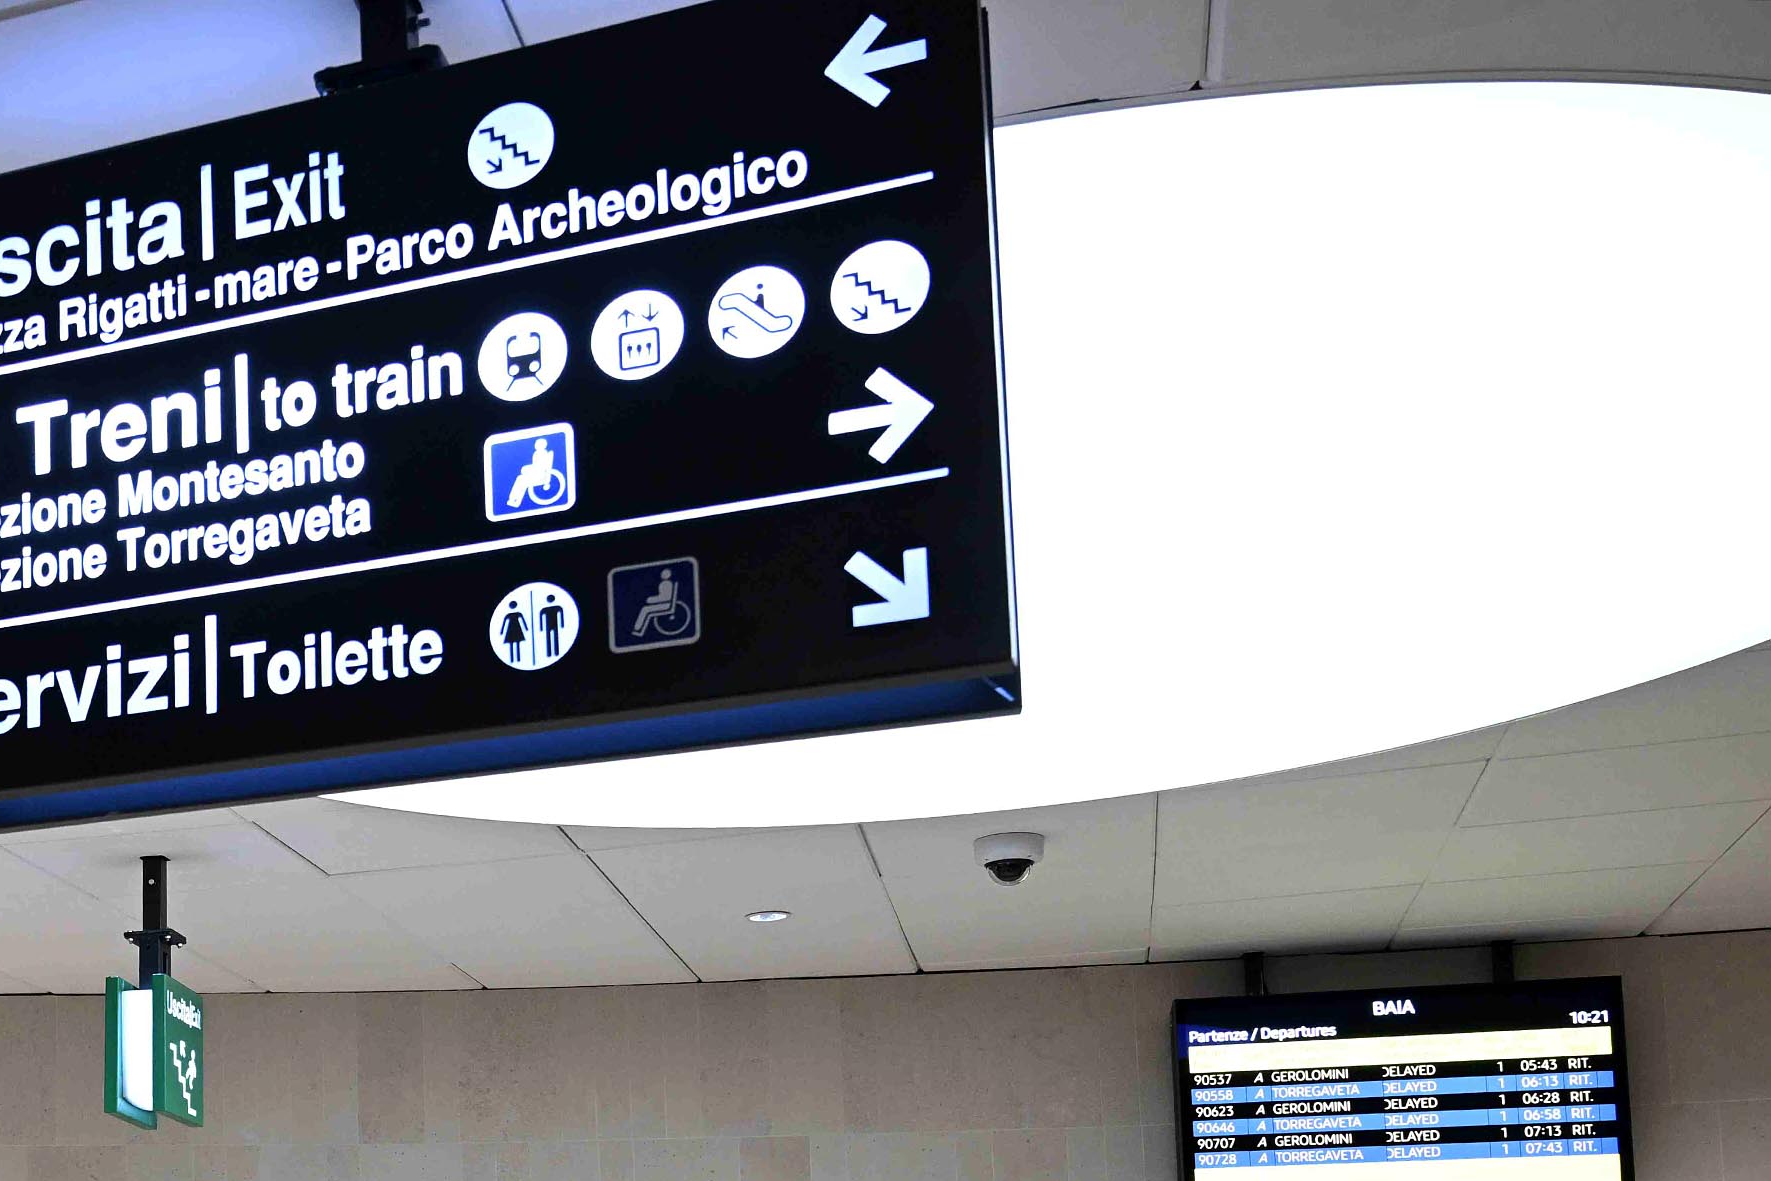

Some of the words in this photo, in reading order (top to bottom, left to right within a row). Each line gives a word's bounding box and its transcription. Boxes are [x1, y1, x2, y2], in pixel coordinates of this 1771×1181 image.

[234, 152, 346, 240] Exit
[59, 273, 187, 343] Rigatti
[488, 150, 808, 251] Archeologico
[16, 367, 222, 476] Treni
[261, 376, 317, 431] to
[332, 345, 464, 419] train
[117, 439, 366, 517] Montesanto
[117, 495, 372, 571] Torregaveta
[230, 624, 444, 698] Toilette
[1372, 999, 1416, 1017] BAIA
[1569, 1010, 1609, 1024] 10:21
[1189, 1029, 1248, 1044] Partenze
[1250, 1027, 1259, 1041] /
[1260, 1026, 1337, 1042] Departures
[1194, 1074, 1232, 1086] 90537
[1254, 1073, 1264, 1083] A
[1271, 1068, 1349, 1083] GEROLOMINI
[1497, 1061, 1504, 1072] 1
[1520, 1059, 1558, 1071] 05:43
[1568, 1057, 1592, 1069] RIT.
[1195, 1090, 1233, 1101] 90558
[1255, 1089, 1265, 1099] A
[1272, 1084, 1360, 1098] TORREGAVETA
[1498, 1078, 1505, 1088] 1
[1521, 1075, 1559, 1087] 06:13
[1569, 1074, 1593, 1086] RIT.
[1196, 1105, 1234, 1118] 90623
[1256, 1105, 1266, 1115] A
[1273, 1101, 1351, 1114] GEROLOMINI
[1499, 1094, 1506, 1105] 1
[1522, 1092, 1560, 1104] 06:28
[1570, 1090, 1594, 1102] RIT.
[1197, 1121, 1235, 1133] 90646
[1257, 1121, 1267, 1131] A
[1274, 1116, 1362, 1131] TORREGAVETA
[1500, 1111, 1507, 1121] 1
[1523, 1108, 1561, 1121] 06:58
[1571, 1107, 1595, 1119] RIT.
[1197, 1138, 1236, 1150] 90707
[1257, 1137, 1267, 1148] A
[1274, 1133, 1353, 1147] GEROLOMINI
[1501, 1127, 1508, 1138] 1
[1524, 1125, 1562, 1138] 07:13
[1572, 1123, 1596, 1136] RIT.
[1198, 1154, 1237, 1166] 90728
[1259, 1153, 1268, 1163] A
[1276, 1149, 1364, 1163] TORREGAVETA
[1502, 1143, 1509, 1154] 1
[1525, 1142, 1563, 1154] 07:43
[1573, 1141, 1597, 1152] RIT.
